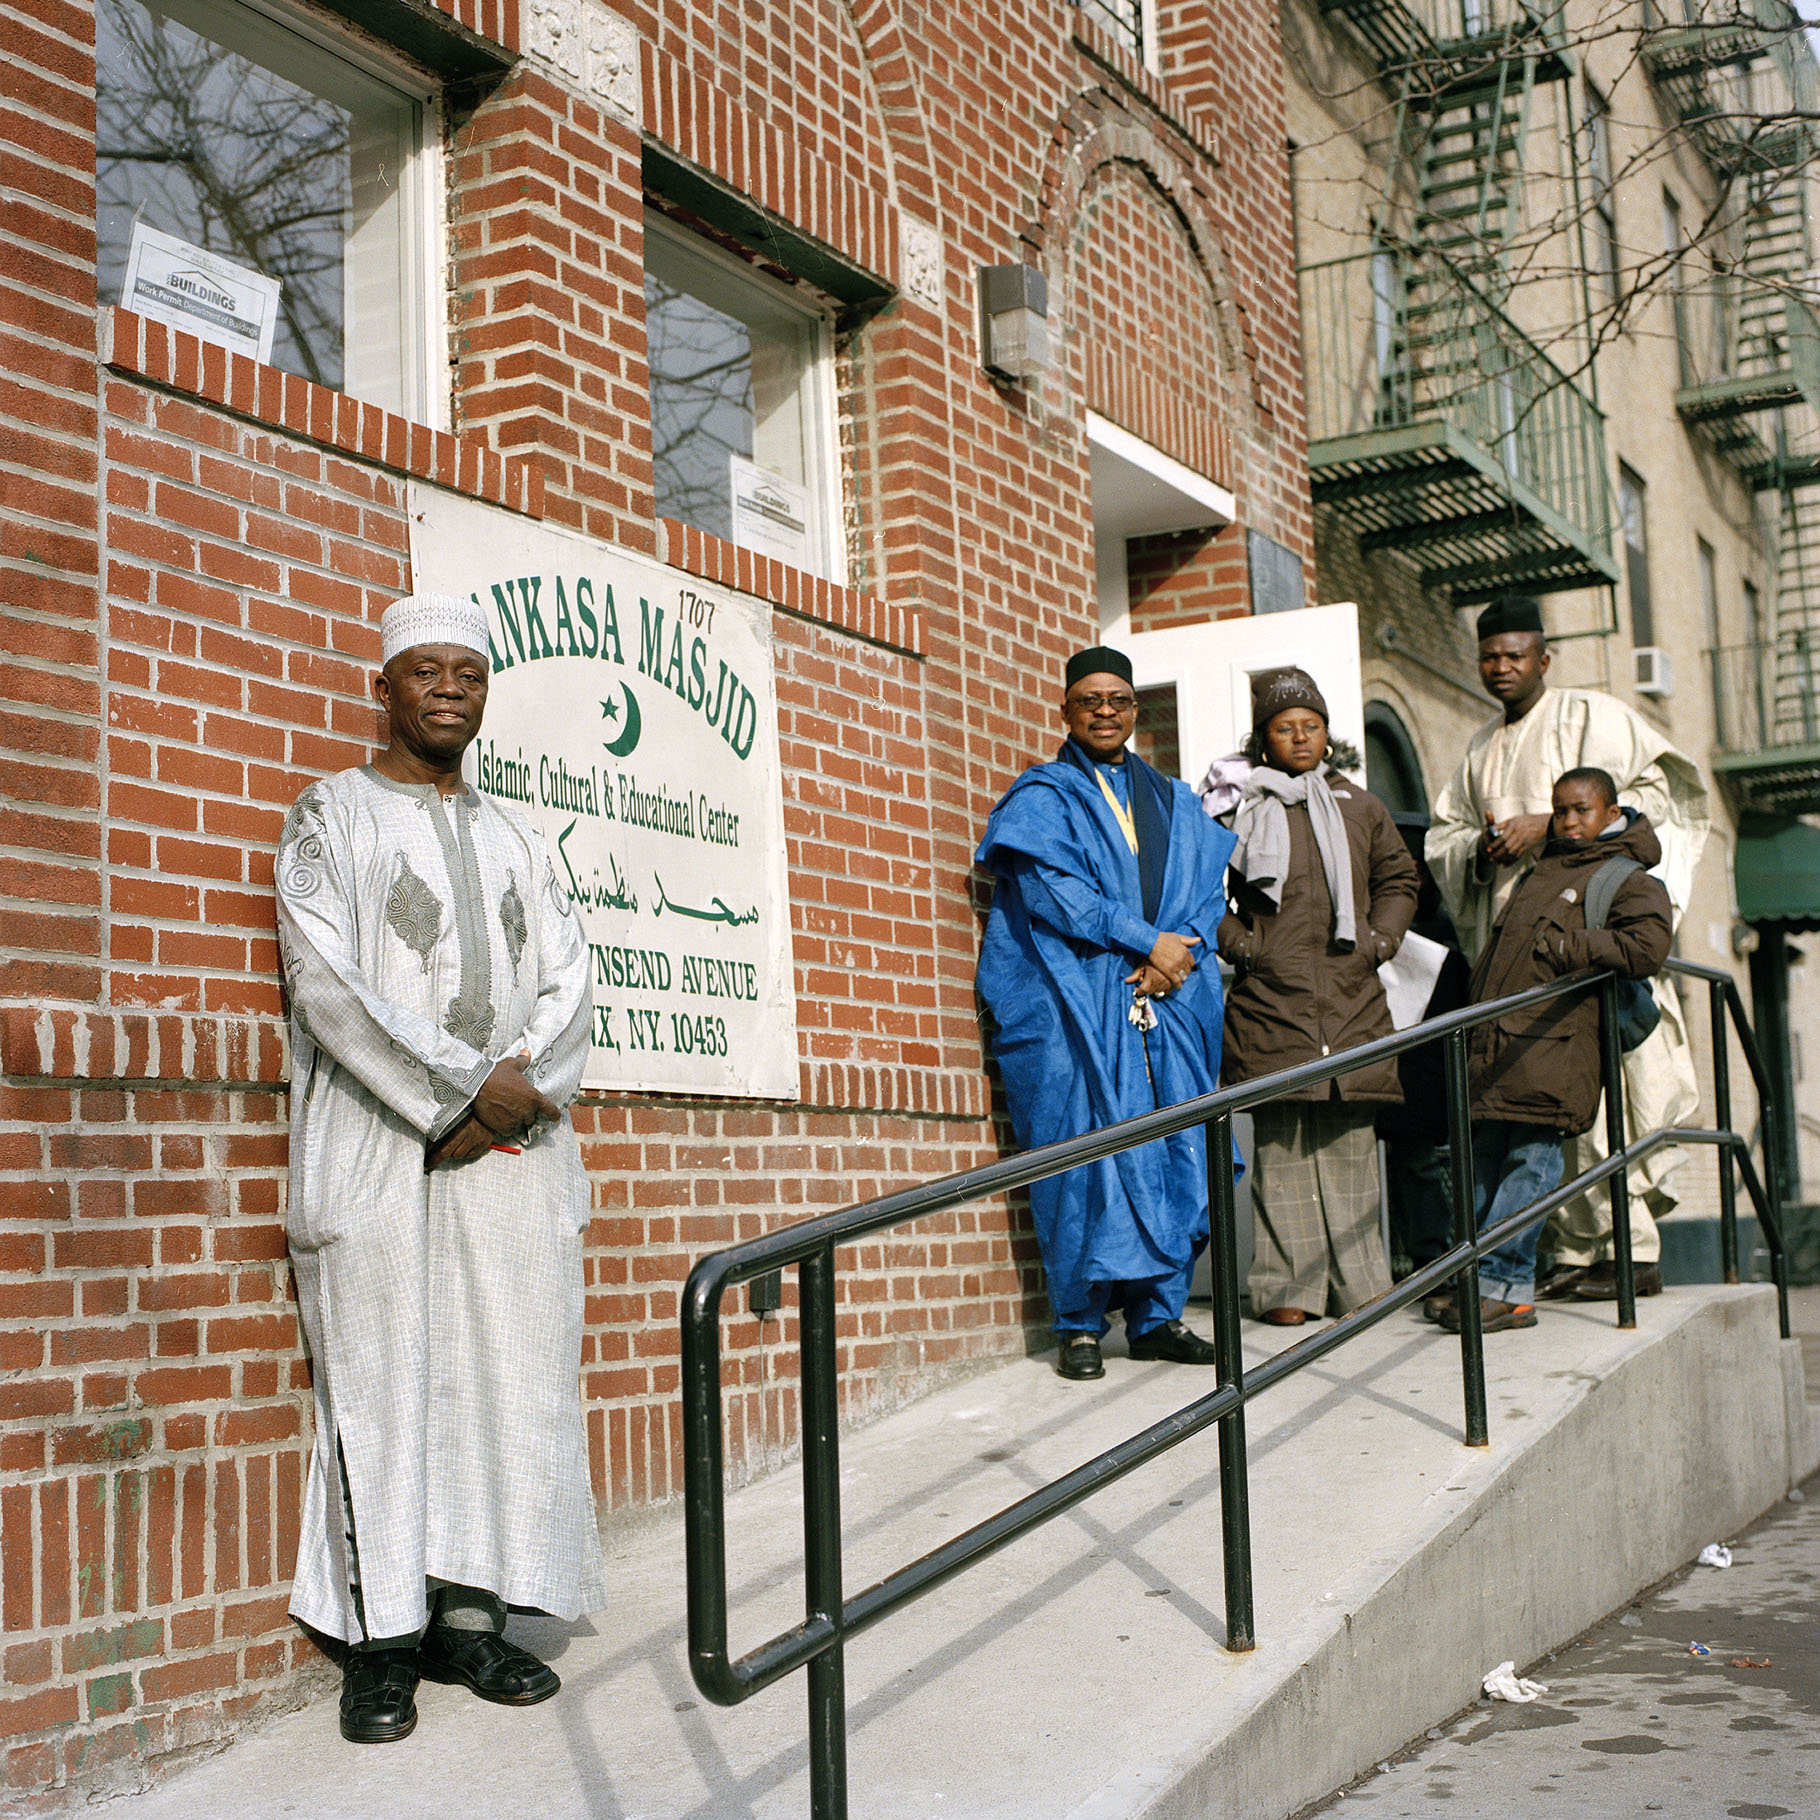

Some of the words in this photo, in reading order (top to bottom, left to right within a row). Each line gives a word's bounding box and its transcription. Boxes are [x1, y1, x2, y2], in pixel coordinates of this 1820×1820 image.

[137, 281, 158, 297] Work
[158, 289, 182, 307] Permit
[170, 274, 236, 312] BUILDINGS
[679, 589, 715, 634] 1707
[638, 596, 757, 761] MASJID
[476, 738, 534, 810] Islamic,
[539, 753, 600, 818] Cultural
[603, 768, 615, 820] &
[618, 773, 695, 839] Educational
[699, 794, 740, 848] Center
[650, 869, 760, 933] مسجد
[588, 943, 671, 991] NSEND
[681, 954, 758, 1001] AVENUE
[626, 1008, 665, 1052] NY.
[671, 1012, 728, 1057] 10453
